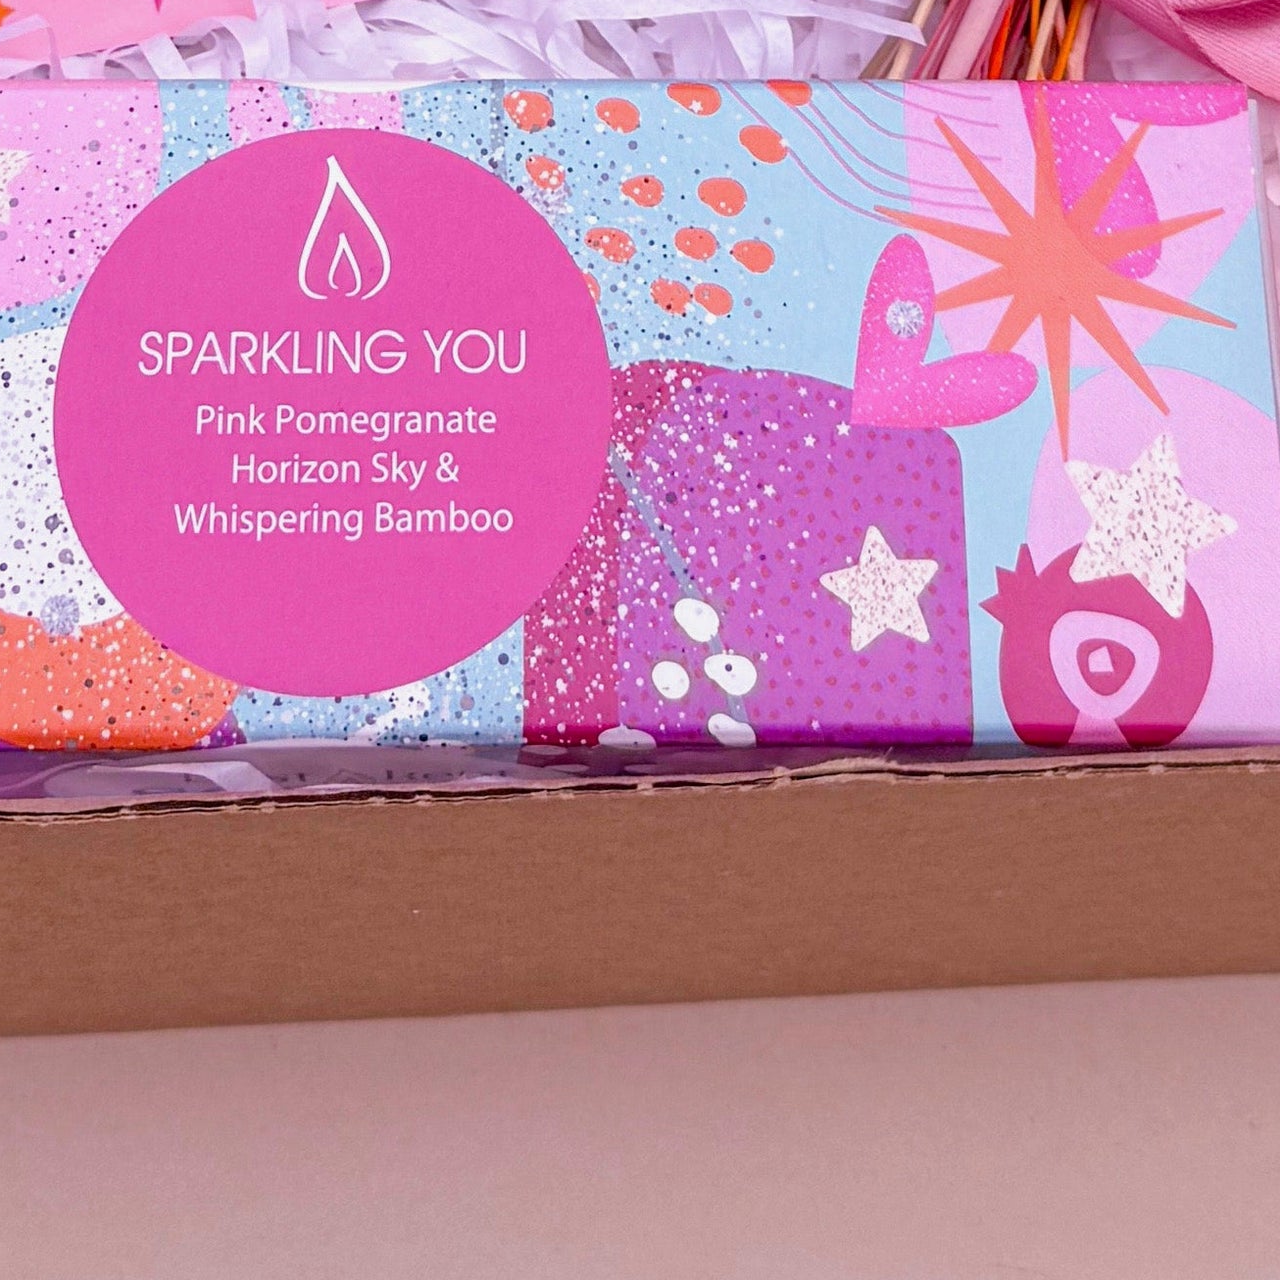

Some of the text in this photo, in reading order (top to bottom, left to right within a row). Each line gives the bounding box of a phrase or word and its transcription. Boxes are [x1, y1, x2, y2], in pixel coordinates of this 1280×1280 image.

[138, 329, 527, 376] SPARKLING YOU
[196, 404, 497, 442] Pink Pomegranate
[232, 451, 460, 491] Horizon Sky &
[173, 501, 514, 541] Whispering Bamboo
